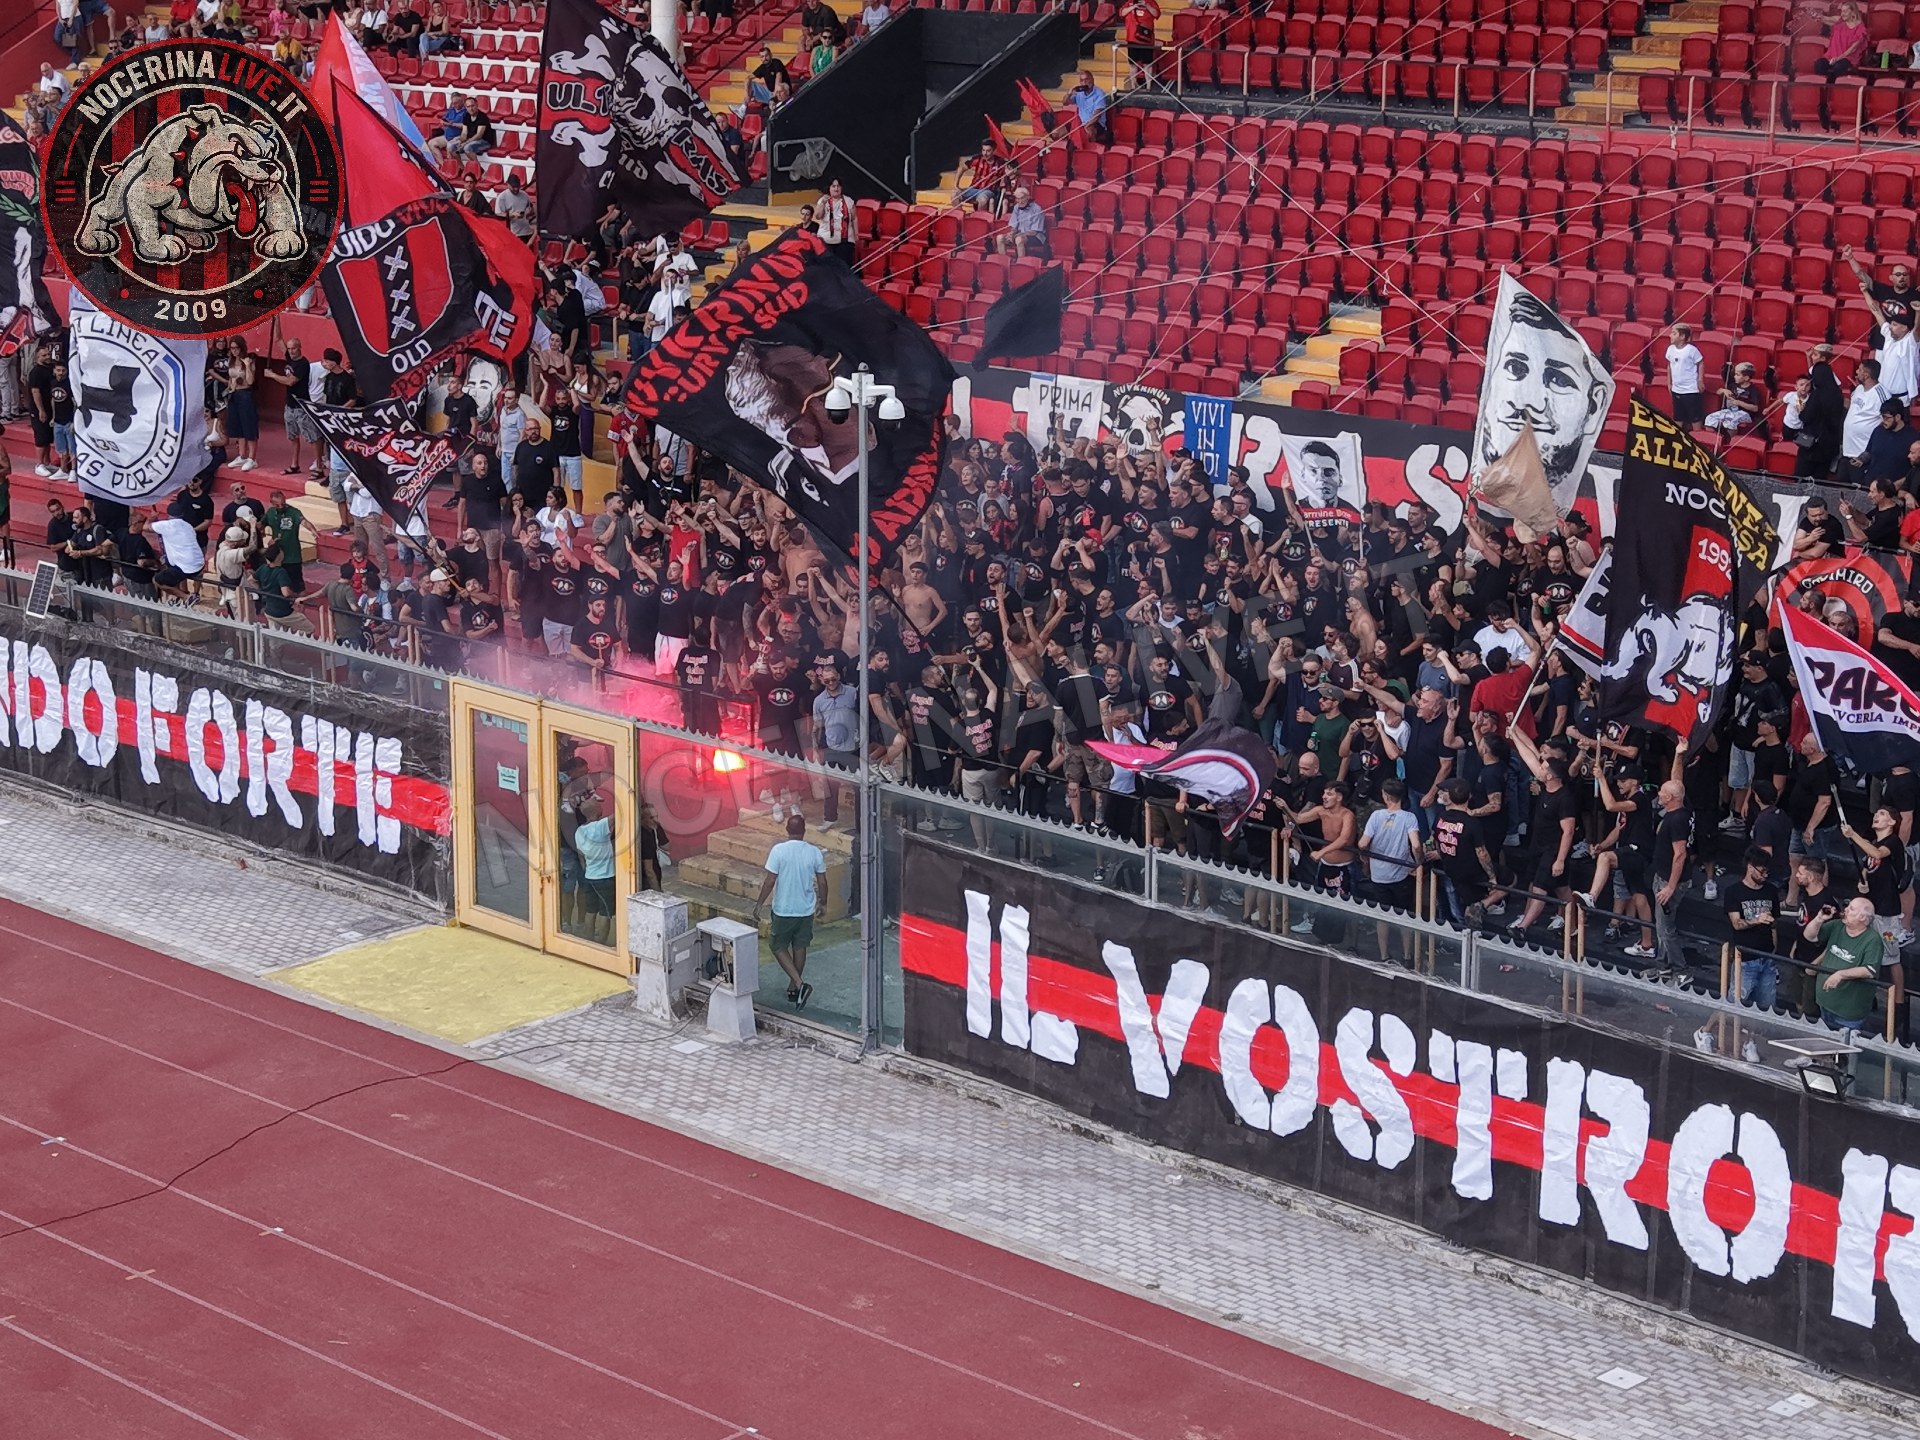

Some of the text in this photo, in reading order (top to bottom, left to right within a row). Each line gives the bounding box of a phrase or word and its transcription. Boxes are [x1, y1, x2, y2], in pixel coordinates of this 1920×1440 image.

[754, 282, 809, 329] SUD
[91, 315, 160, 365] LINEA
[391, 339, 433, 374] OLD
[1039, 384, 1093, 413] PRIMA
[1191, 400, 1226, 428] VIVI
[111, 428, 179, 491] PORTICI
[1197, 428, 1216, 451] IN
[1630, 433, 1710, 481] ALLA
[1191, 450, 1220, 478] OI
[1303, 509, 1335, 519] armine
[135, 666, 403, 855] FORTE
[963, 888, 1080, 1066] IL
[1102, 938, 1793, 1286] VOSTRO
